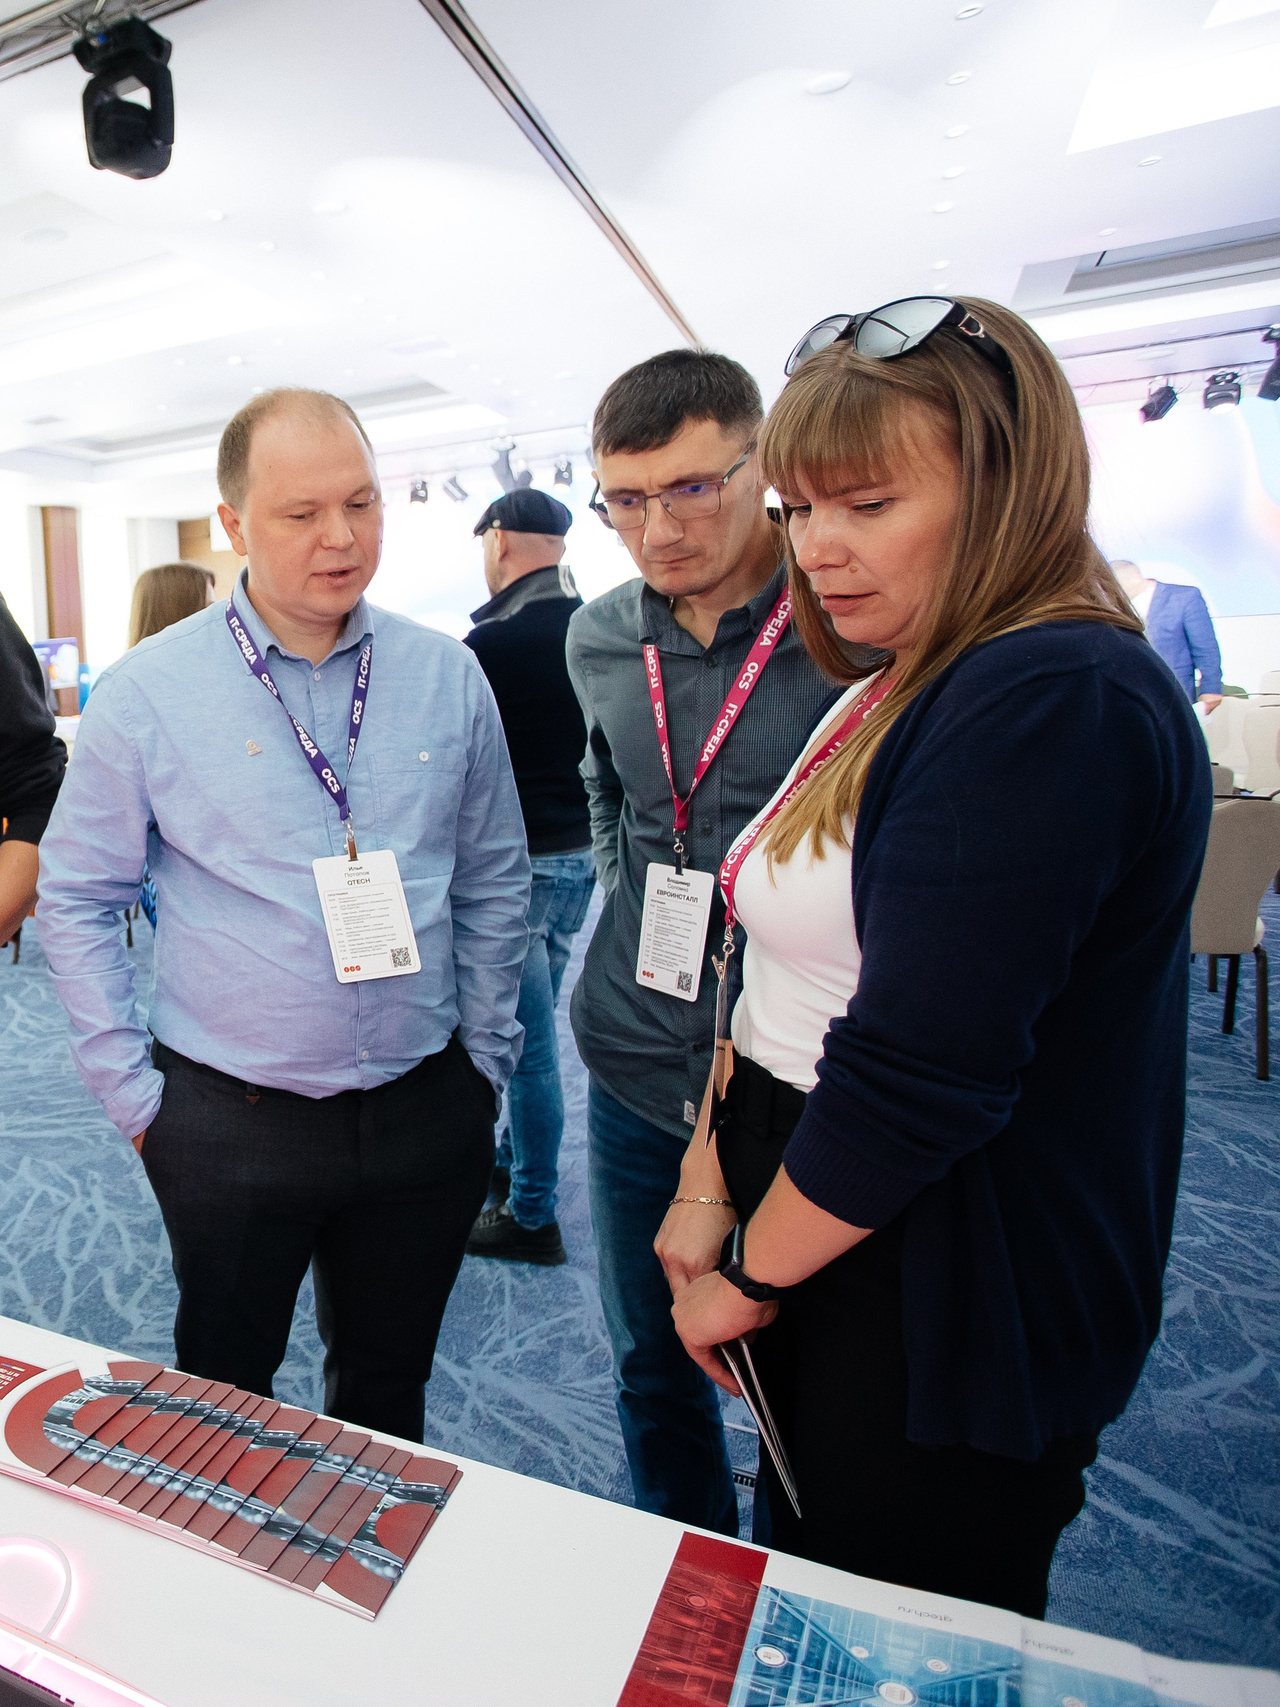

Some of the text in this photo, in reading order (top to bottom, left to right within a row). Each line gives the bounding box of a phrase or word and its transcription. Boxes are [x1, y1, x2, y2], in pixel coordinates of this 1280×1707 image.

[759, 591, 793, 646] -СРЕДА
[229, 616, 259, 665] IT-СРЕДА
[646, 644, 659, 689] IT-СРЕ
[738, 661, 759, 690] OCS
[260, 673, 278, 697] OCS
[352, 699, 363, 725] OCS
[655, 701, 663, 728] OCS
[701, 702, 738, 762] IT-СРЕДА
[321, 768, 340, 794] OCS
[347, 878, 370, 886] QTECH
[898, 1606, 952, 1622] qtech.ru
[1023, 1638, 1074, 1655] qtech.r
